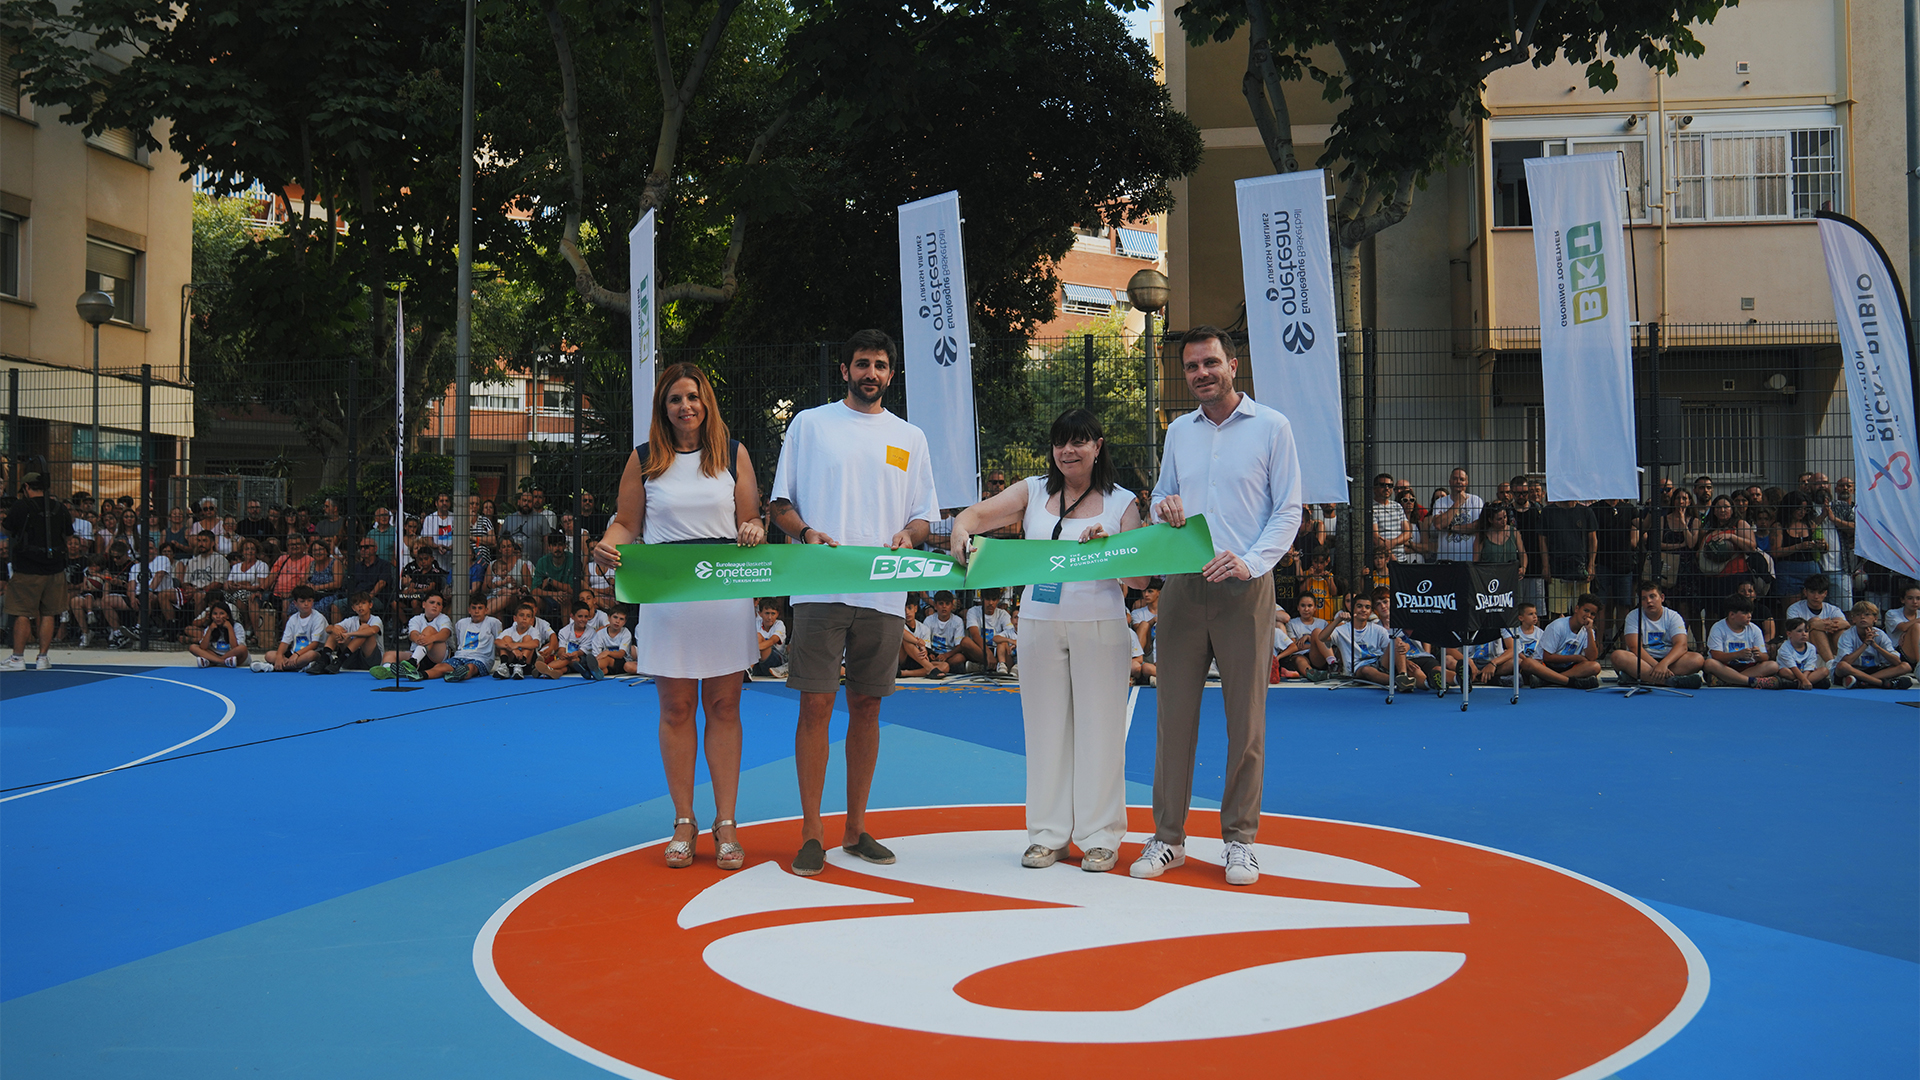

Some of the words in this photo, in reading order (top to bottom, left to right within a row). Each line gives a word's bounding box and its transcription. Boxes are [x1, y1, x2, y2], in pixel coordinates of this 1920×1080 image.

[1069, 552, 1100, 563] RICKY
[1104, 547, 1138, 557] RUBIO
[716, 567, 771, 577] oneteam
[872, 558, 951, 576] BKT
[1395, 592, 1457, 610] SPALDING
[1475, 591, 1513, 610] SPALDING
